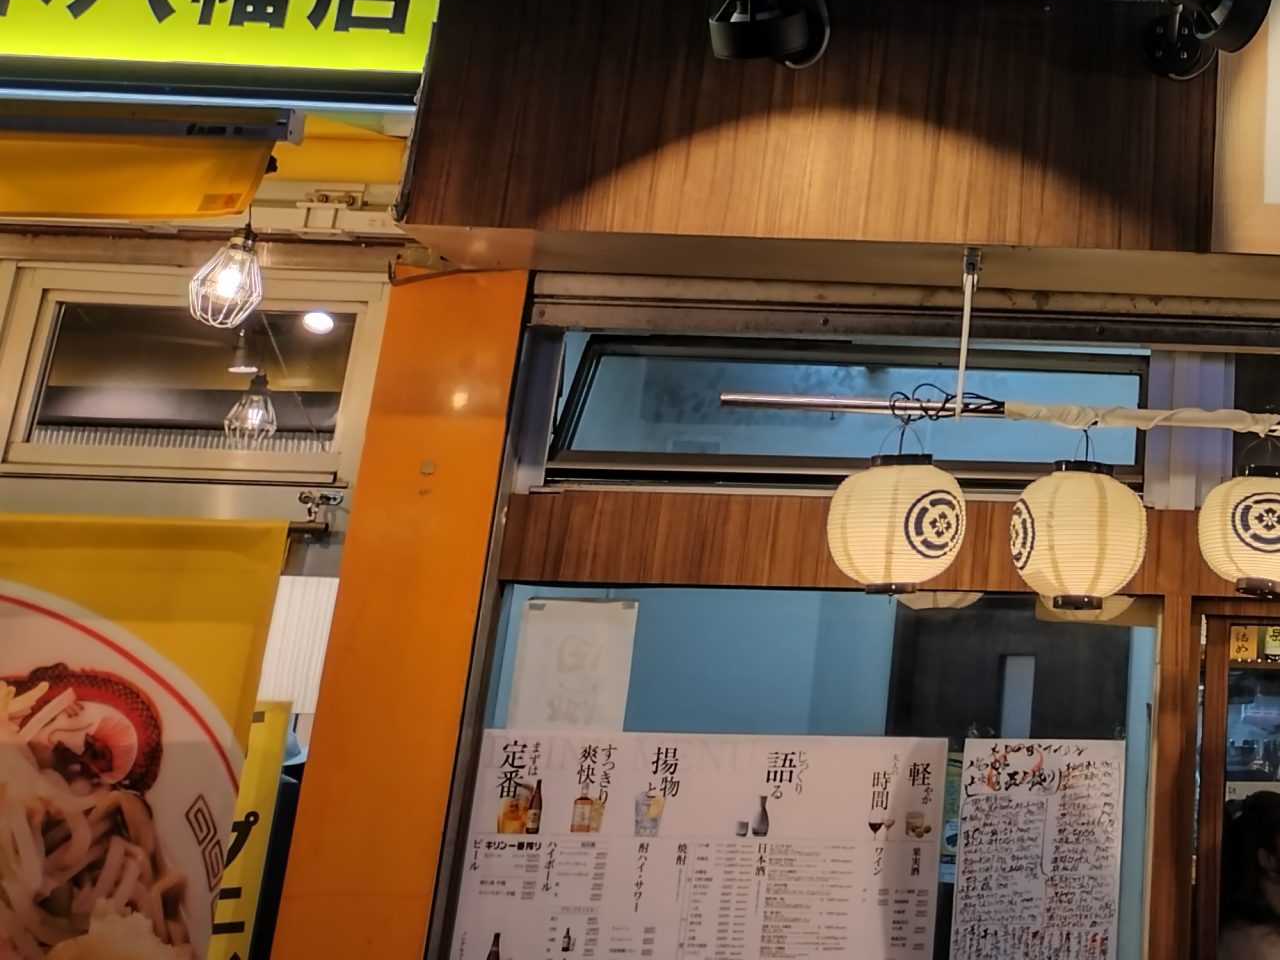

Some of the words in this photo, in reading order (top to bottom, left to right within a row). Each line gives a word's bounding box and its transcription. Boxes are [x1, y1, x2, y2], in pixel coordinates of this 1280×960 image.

[495, 739, 528, 800] 定番
[527, 741, 542, 777] まずは
[576, 744, 600, 786] 爽快
[598, 743, 618, 805] すっきり
[765, 750, 797, 801] 語る
[871, 770, 892, 811] 時間
[908, 761, 934, 806] 軽やか
[469, 838, 483, 872] ビール
[540, 840, 559, 893] ハイボール
[675, 843, 688, 866] 焼酎
[755, 843, 767, 876] 日本酒
[873, 847, 884, 876] ワイン
[910, 847, 921, 876] 果実酒
[633, 842, 650, 914] 酎ハイ・サワー
